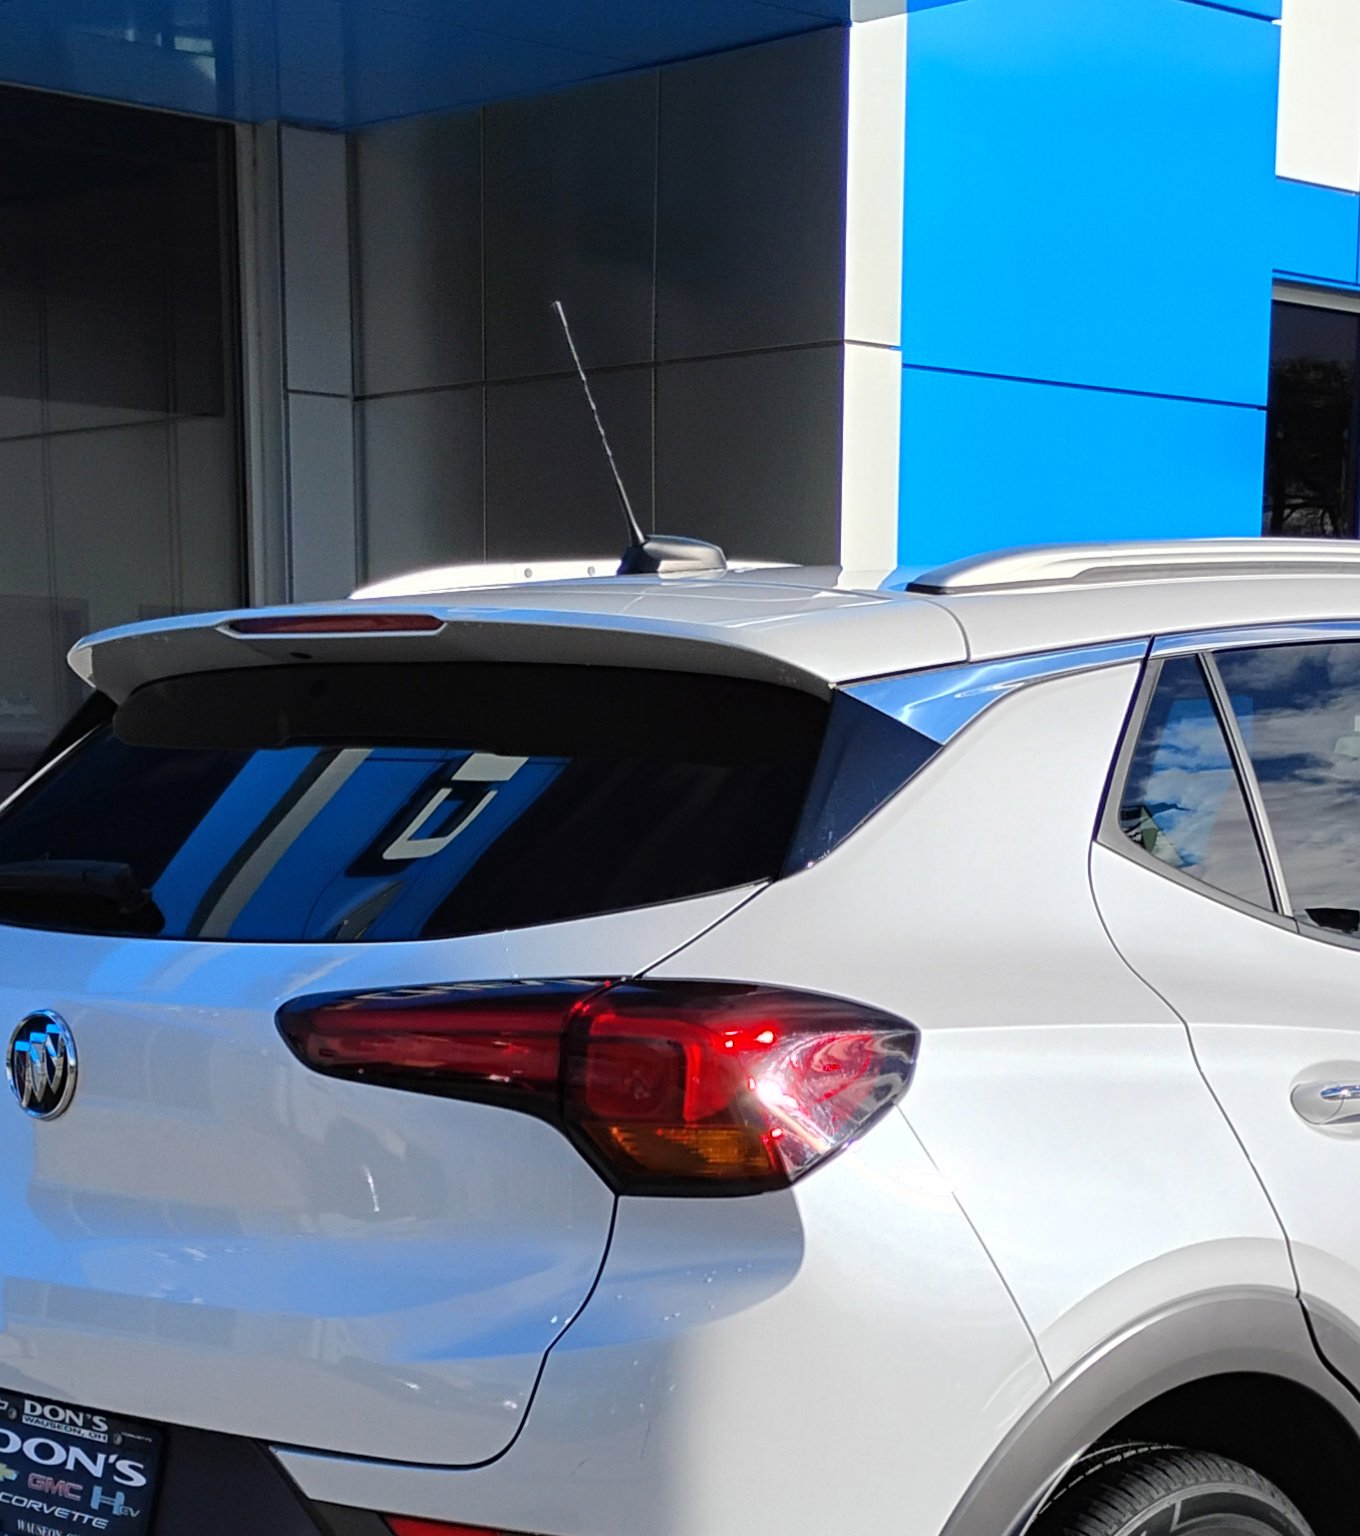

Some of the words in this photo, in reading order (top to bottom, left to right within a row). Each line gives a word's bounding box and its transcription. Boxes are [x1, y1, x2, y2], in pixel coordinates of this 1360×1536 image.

[23, 1399, 109, 1432] DON'S
[23, 1415, 85, 1438] WAUSEON,
[87, 1429, 108, 1442] OH
[27, 1473, 84, 1501] GMC
